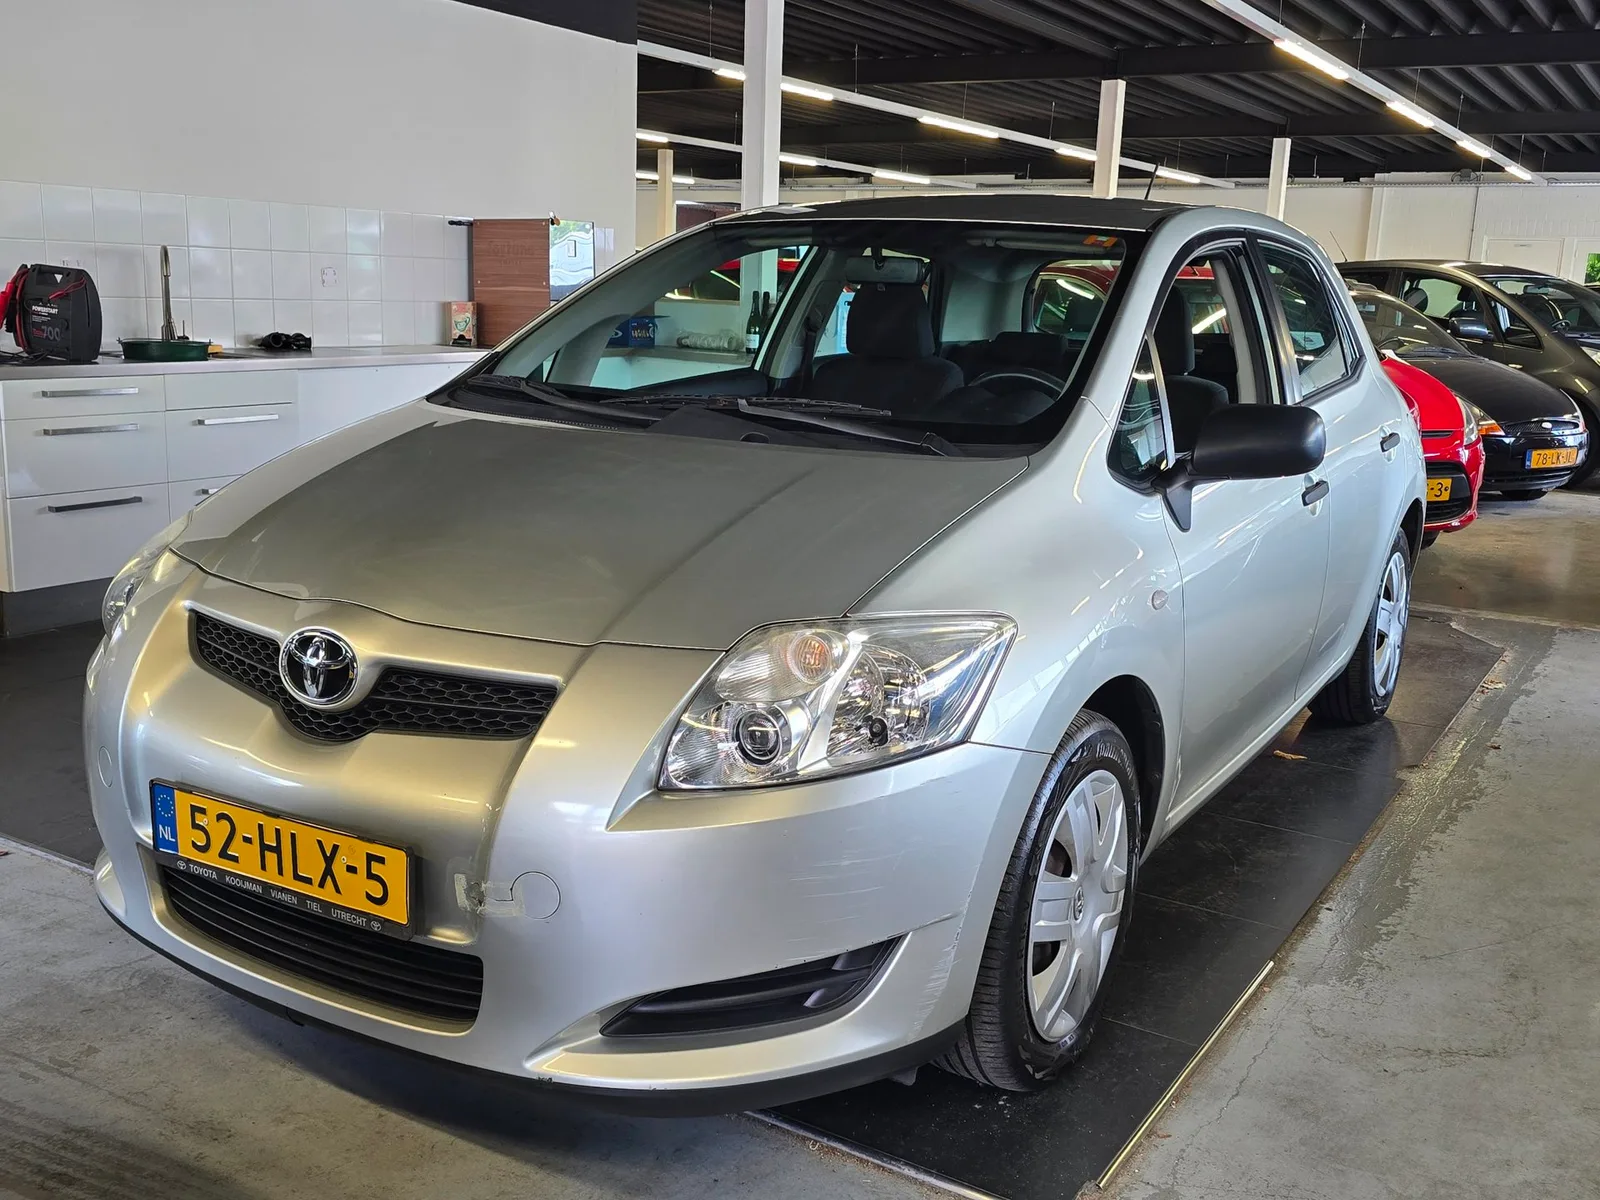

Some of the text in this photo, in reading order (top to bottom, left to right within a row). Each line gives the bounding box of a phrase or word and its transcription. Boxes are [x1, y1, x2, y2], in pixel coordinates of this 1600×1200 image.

[31, 305, 59, 315] POWERSTART
[41, 326, 61, 341] 700
[1535, 452, 1572, 466] 78-LK-JL
[159, 825, 176, 842] NL
[189, 803, 389, 906] 52-HLX-5
[188, 863, 367, 927] TOYOTA KOOIJMAN VIANEN TIEL UTRECHT
